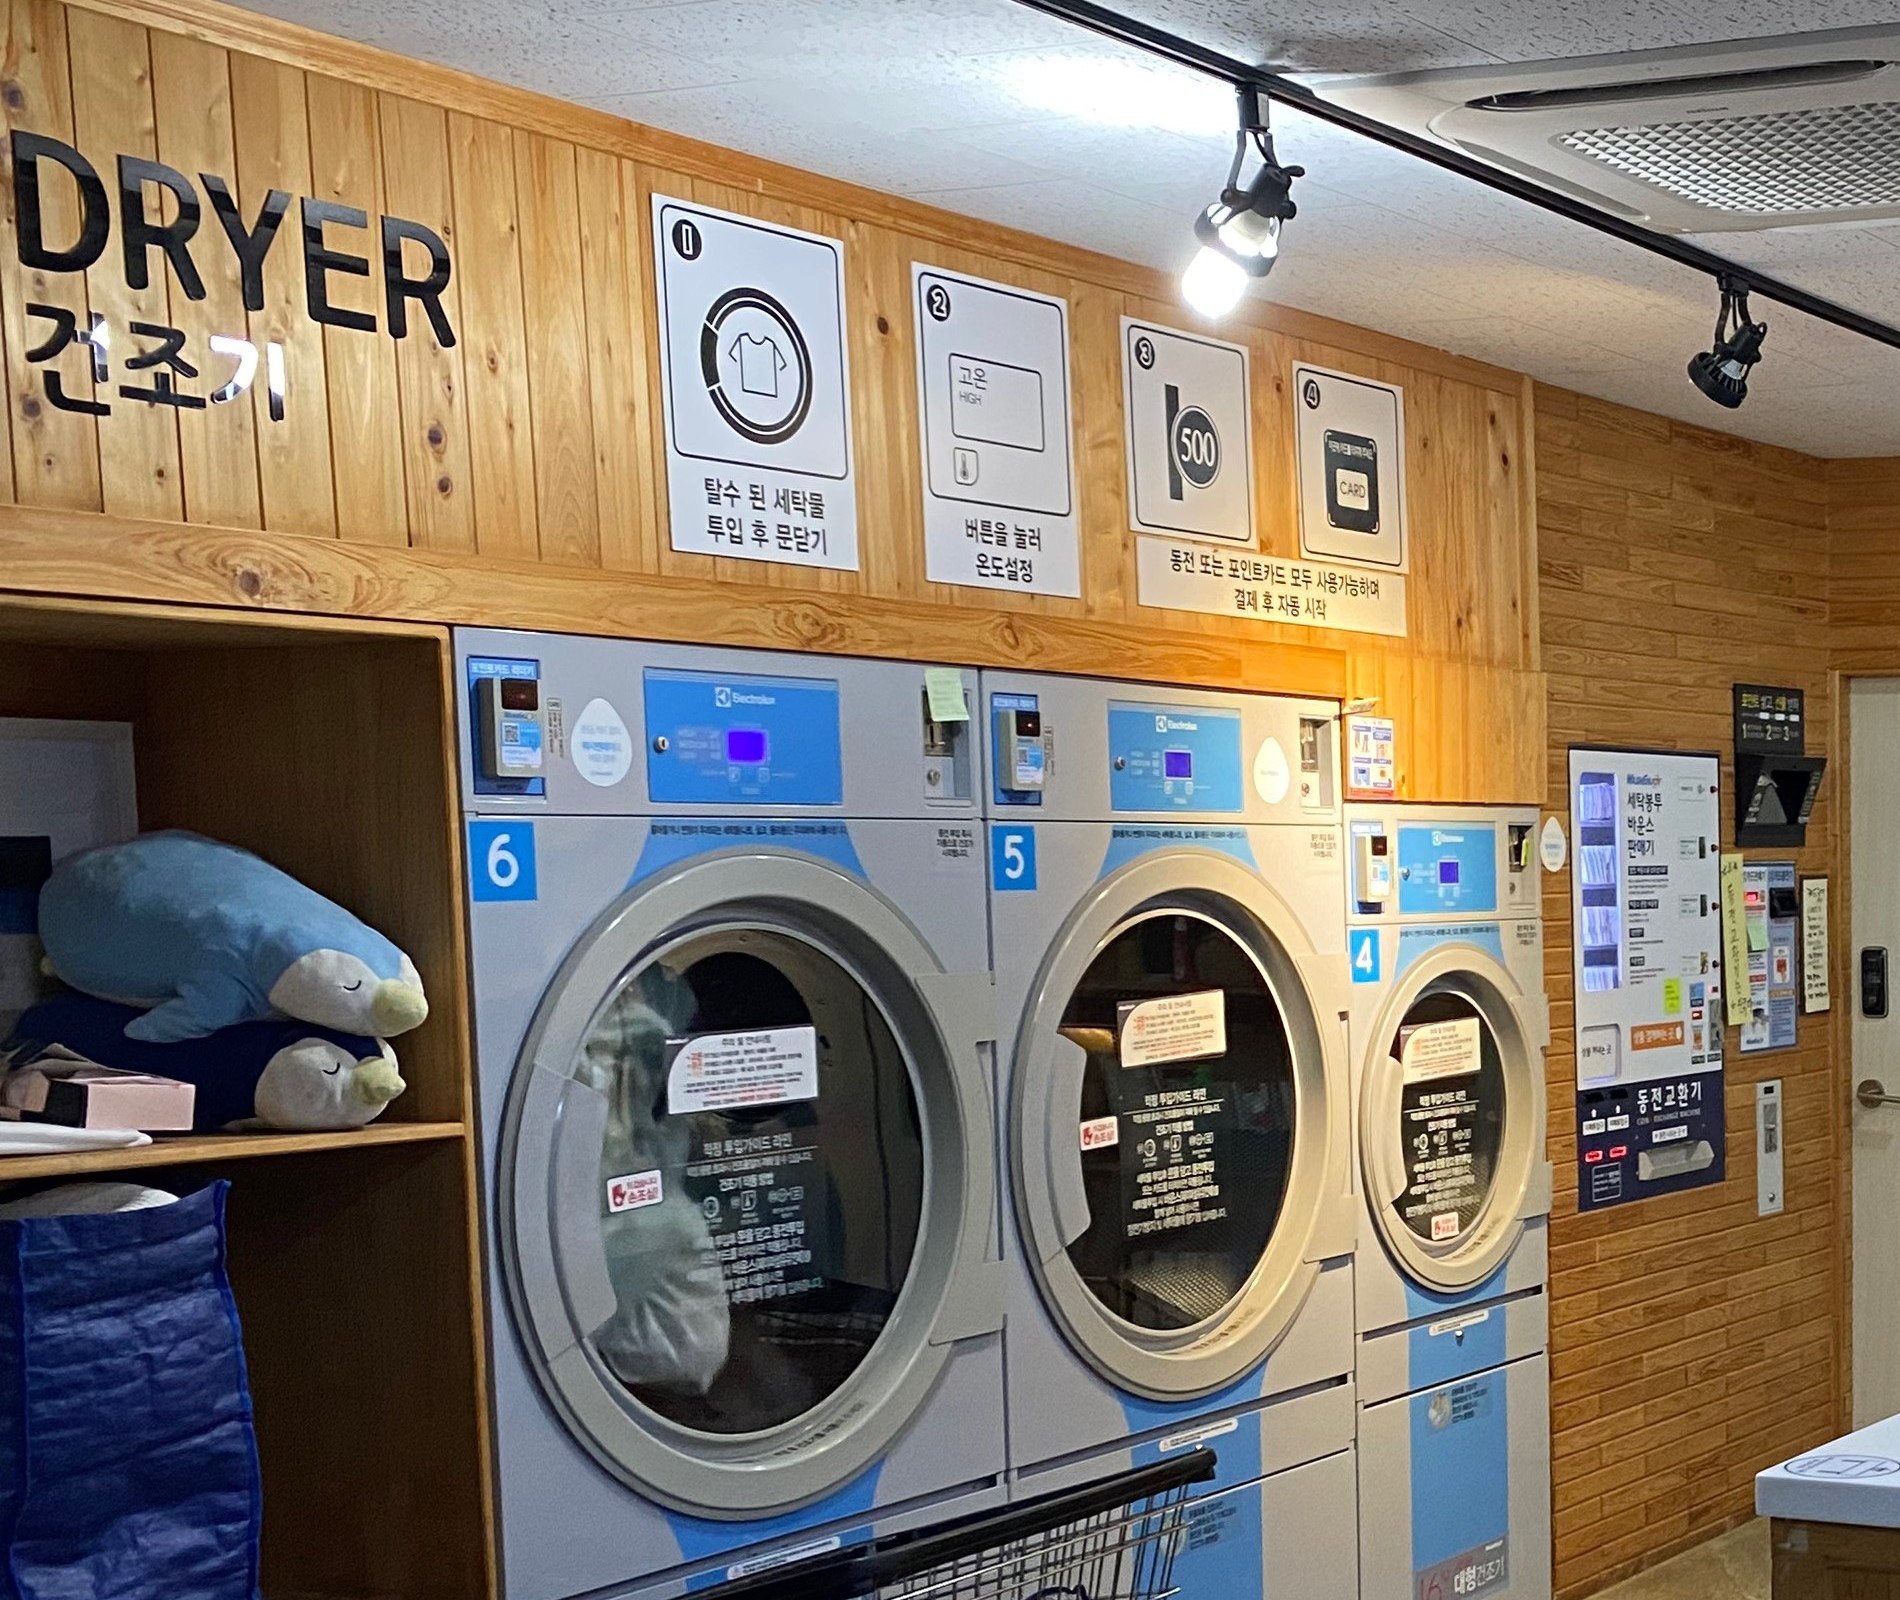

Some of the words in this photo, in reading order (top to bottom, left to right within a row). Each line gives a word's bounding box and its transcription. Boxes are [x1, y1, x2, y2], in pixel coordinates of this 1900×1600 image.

[11, 130, 456, 347] DRYER
[26, 303, 285, 421] 건조기
[959, 366, 988, 390] 고온
[1180, 427, 1215, 467] 500
[704, 477, 741, 508] 탈수
[749, 483, 766, 511] 된
[773, 487, 825, 520] 세탁물
[1340, 481, 1366, 499] CARD
[707, 514, 744, 546] 투입
[751, 519, 769, 548] 후
[775, 523, 828, 556] 문닫기
[965, 518, 1008, 547] 버튼을
[1013, 523, 1042, 551] 눌러
[975, 553, 1033, 583] 온도설정
[1170, 549, 1195, 573] 동전
[1199, 554, 1224, 577] 또는
[1228, 558, 1286, 586] 포인트카드
[1290, 567, 1312, 587] 모두
[1317, 570, 1380, 599] 사용가능하며
[1234, 588, 1258, 612] 결제
[1262, 592, 1273, 613] 후
[1277, 595, 1300, 616] 자동
[1304, 599, 1326, 620] 시작
[1627, 792, 1663, 813] 세탁봉투
[1627, 816, 1655, 836] 바운스
[487, 833, 520, 888] 6
[1004, 835, 1026, 879] 5
[1355, 936, 1373, 973] 4
[1637, 1081, 1701, 1114] 동전교환기
[1454, 1556, 1505, 1595] 대형건조기
